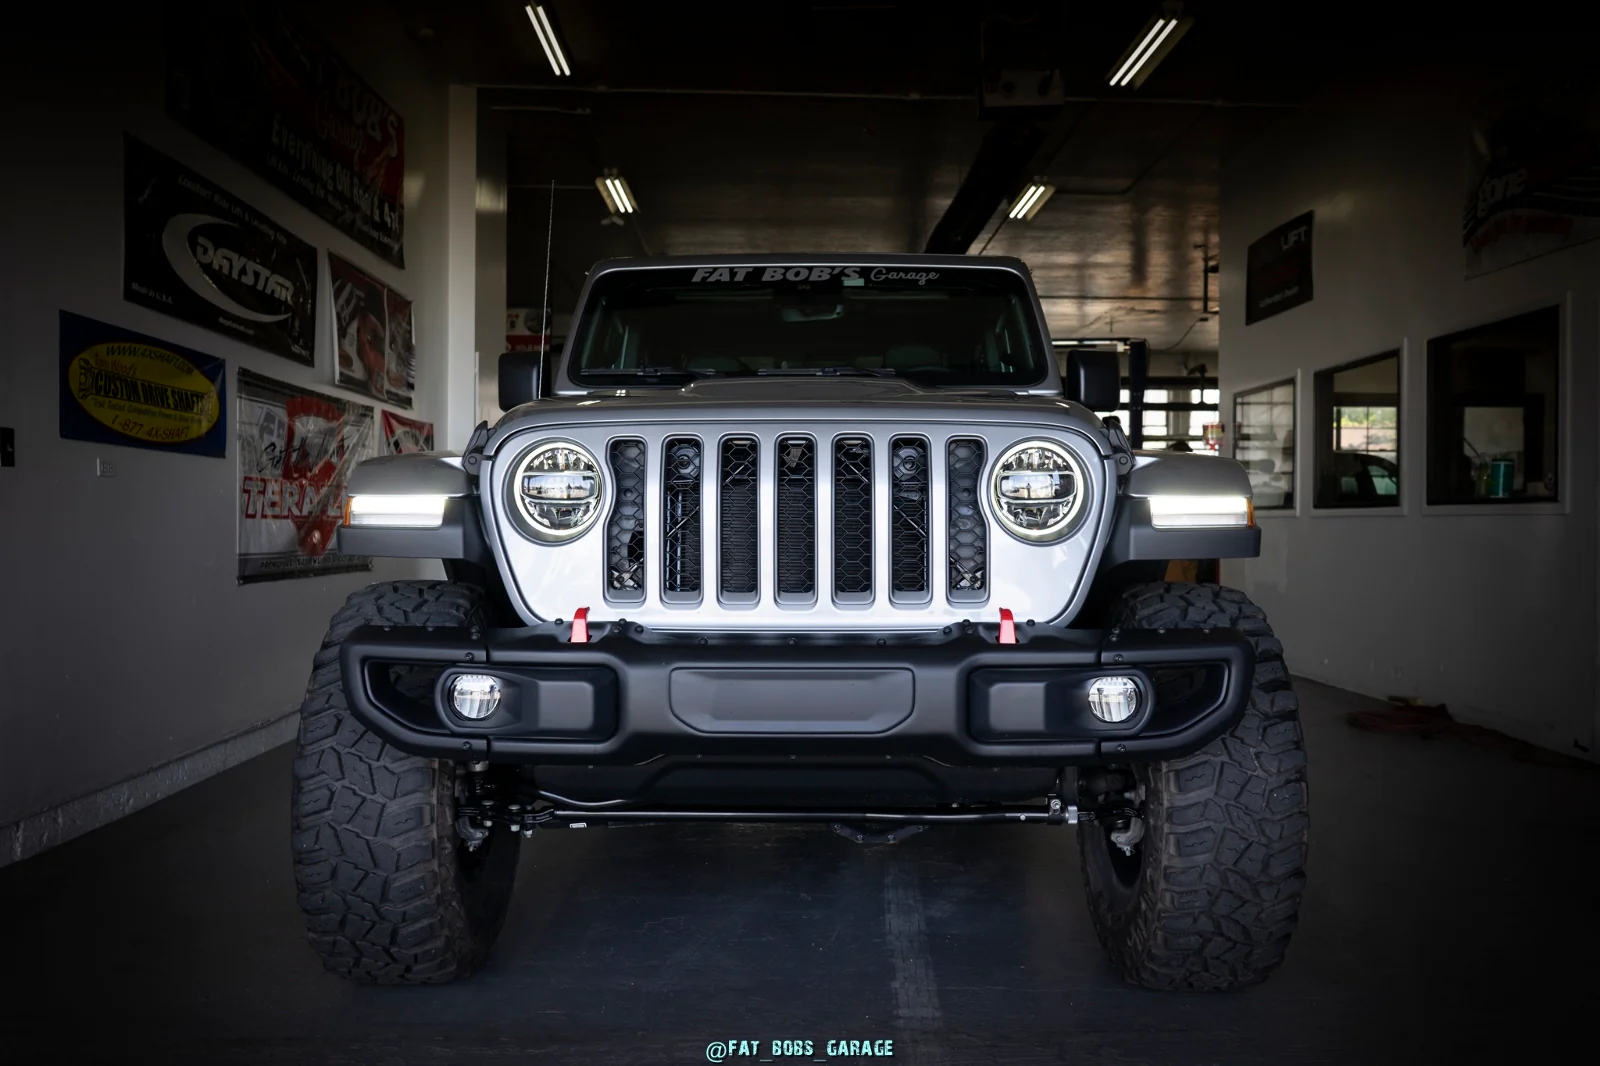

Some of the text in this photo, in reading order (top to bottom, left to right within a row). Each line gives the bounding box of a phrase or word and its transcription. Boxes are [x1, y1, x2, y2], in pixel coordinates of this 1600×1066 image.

[271, 111, 334, 192] Everything
[196, 234, 294, 306] DAYSTAR
[691, 267, 940, 286] FAT BOB'S Garage
[94, 370, 141, 402] CUSTOM
[140, 381, 169, 410] DRIVE
